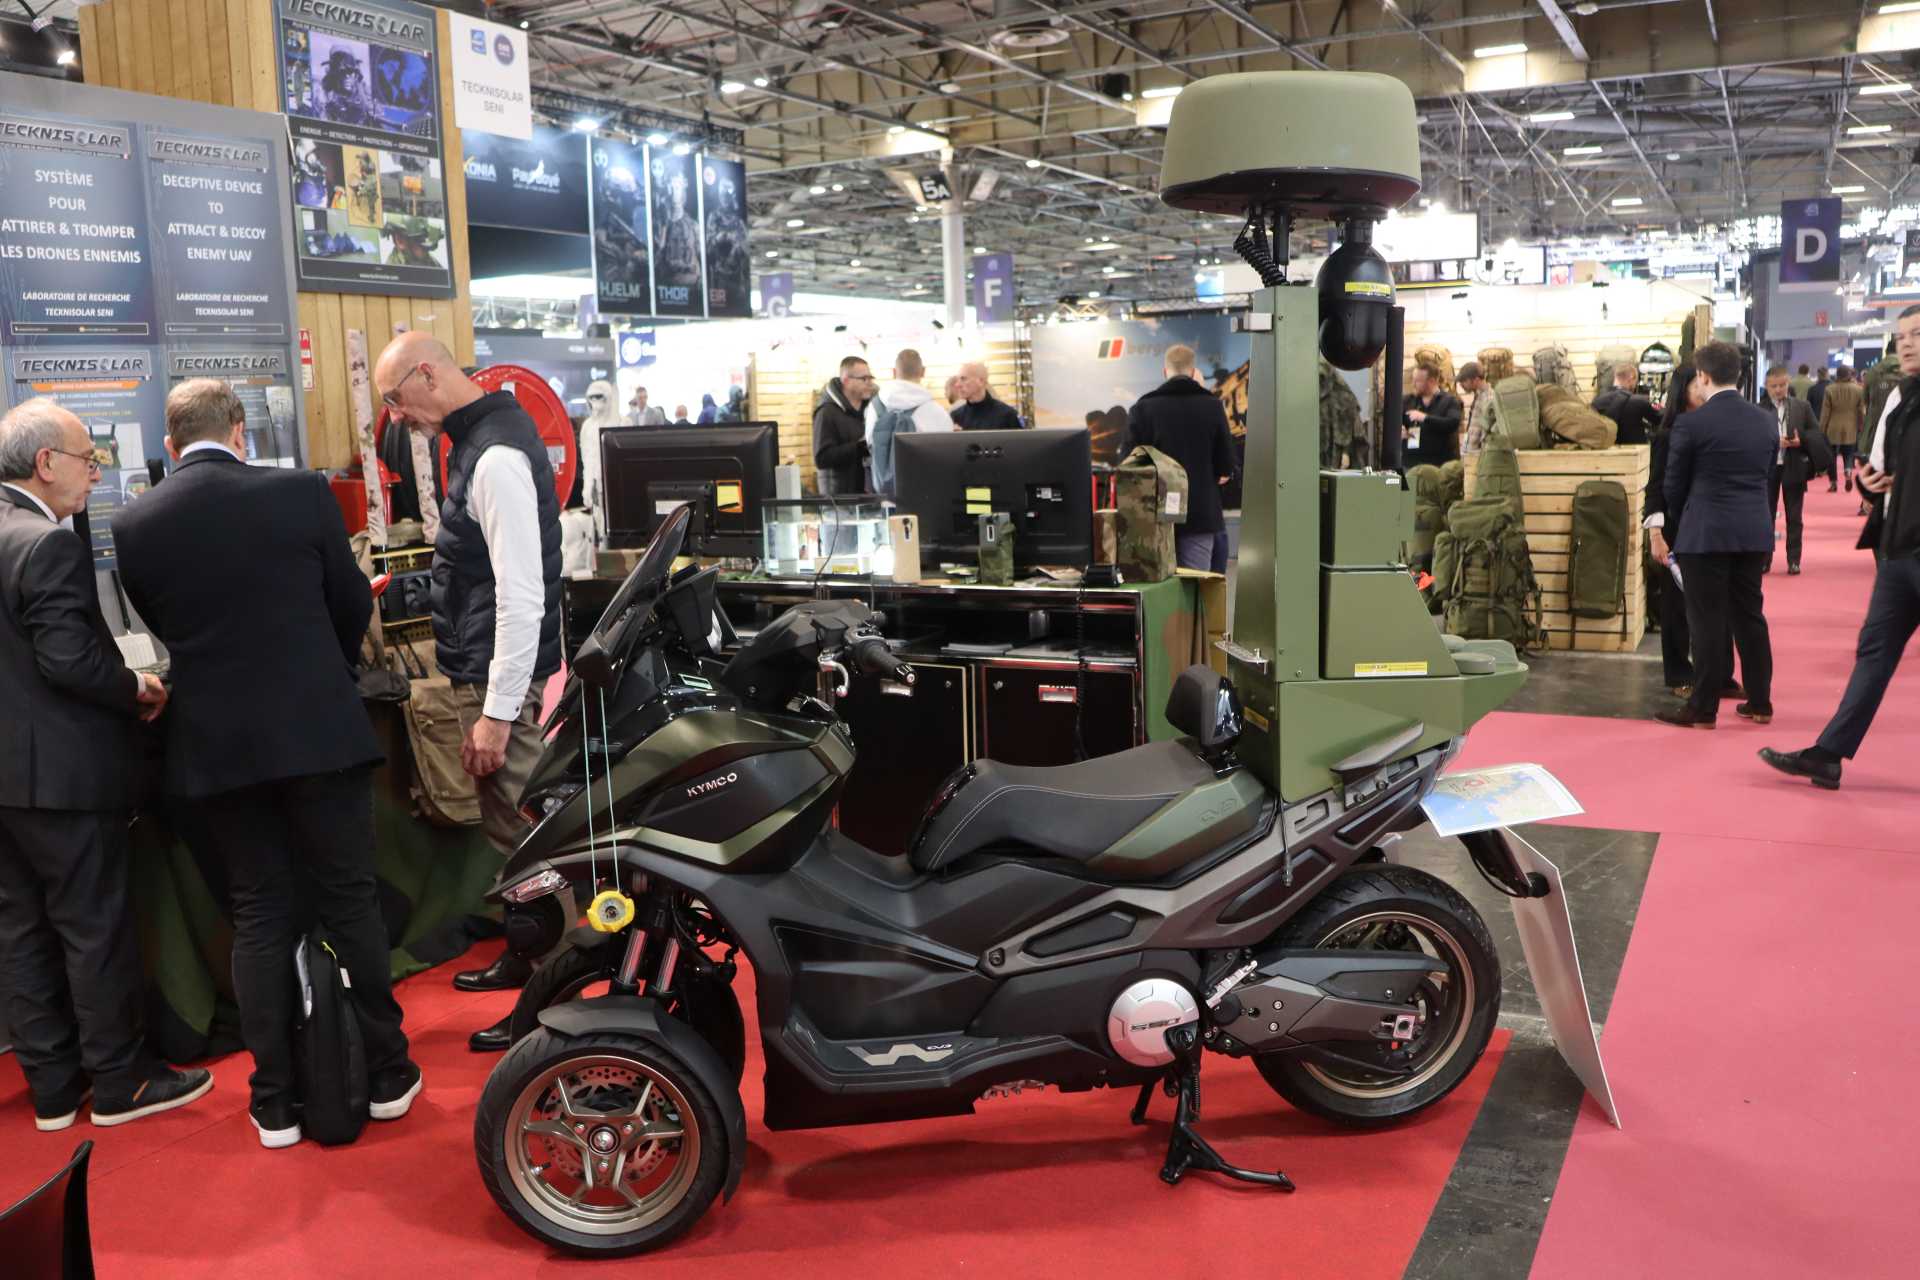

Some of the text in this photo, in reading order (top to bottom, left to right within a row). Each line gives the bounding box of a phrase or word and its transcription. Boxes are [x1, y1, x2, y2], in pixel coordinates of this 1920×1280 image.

[461, 80, 524, 103] TECKNISOLAR
[483, 100, 504, 114] SENI
[34, 169, 95, 187] SYSTÈME
[162, 174, 263, 195] DECEPTIVE DEVICE
[921, 180, 951, 200] 5A
[48, 196, 87, 212] POUR
[207, 201, 224, 215] TO
[1, 219, 135, 239] ATTIRER & TROMPER
[167, 222, 266, 240] ATTRACT & DECOY
[0, 244, 142, 264] LES DRONES ENNEMIS
[187, 247, 252, 262] ENEMY UAV
[1796, 228, 1828, 263] D
[22, 291, 131, 303] LABORATOIRE DE RECHERCHE
[657, 285, 689, 300] THOR
[984, 278, 1002, 308] F
[45, 307, 96, 317] TECKNISOLAR
[768, 295, 788, 319] G
[687, 772, 738, 797] KYMCO
